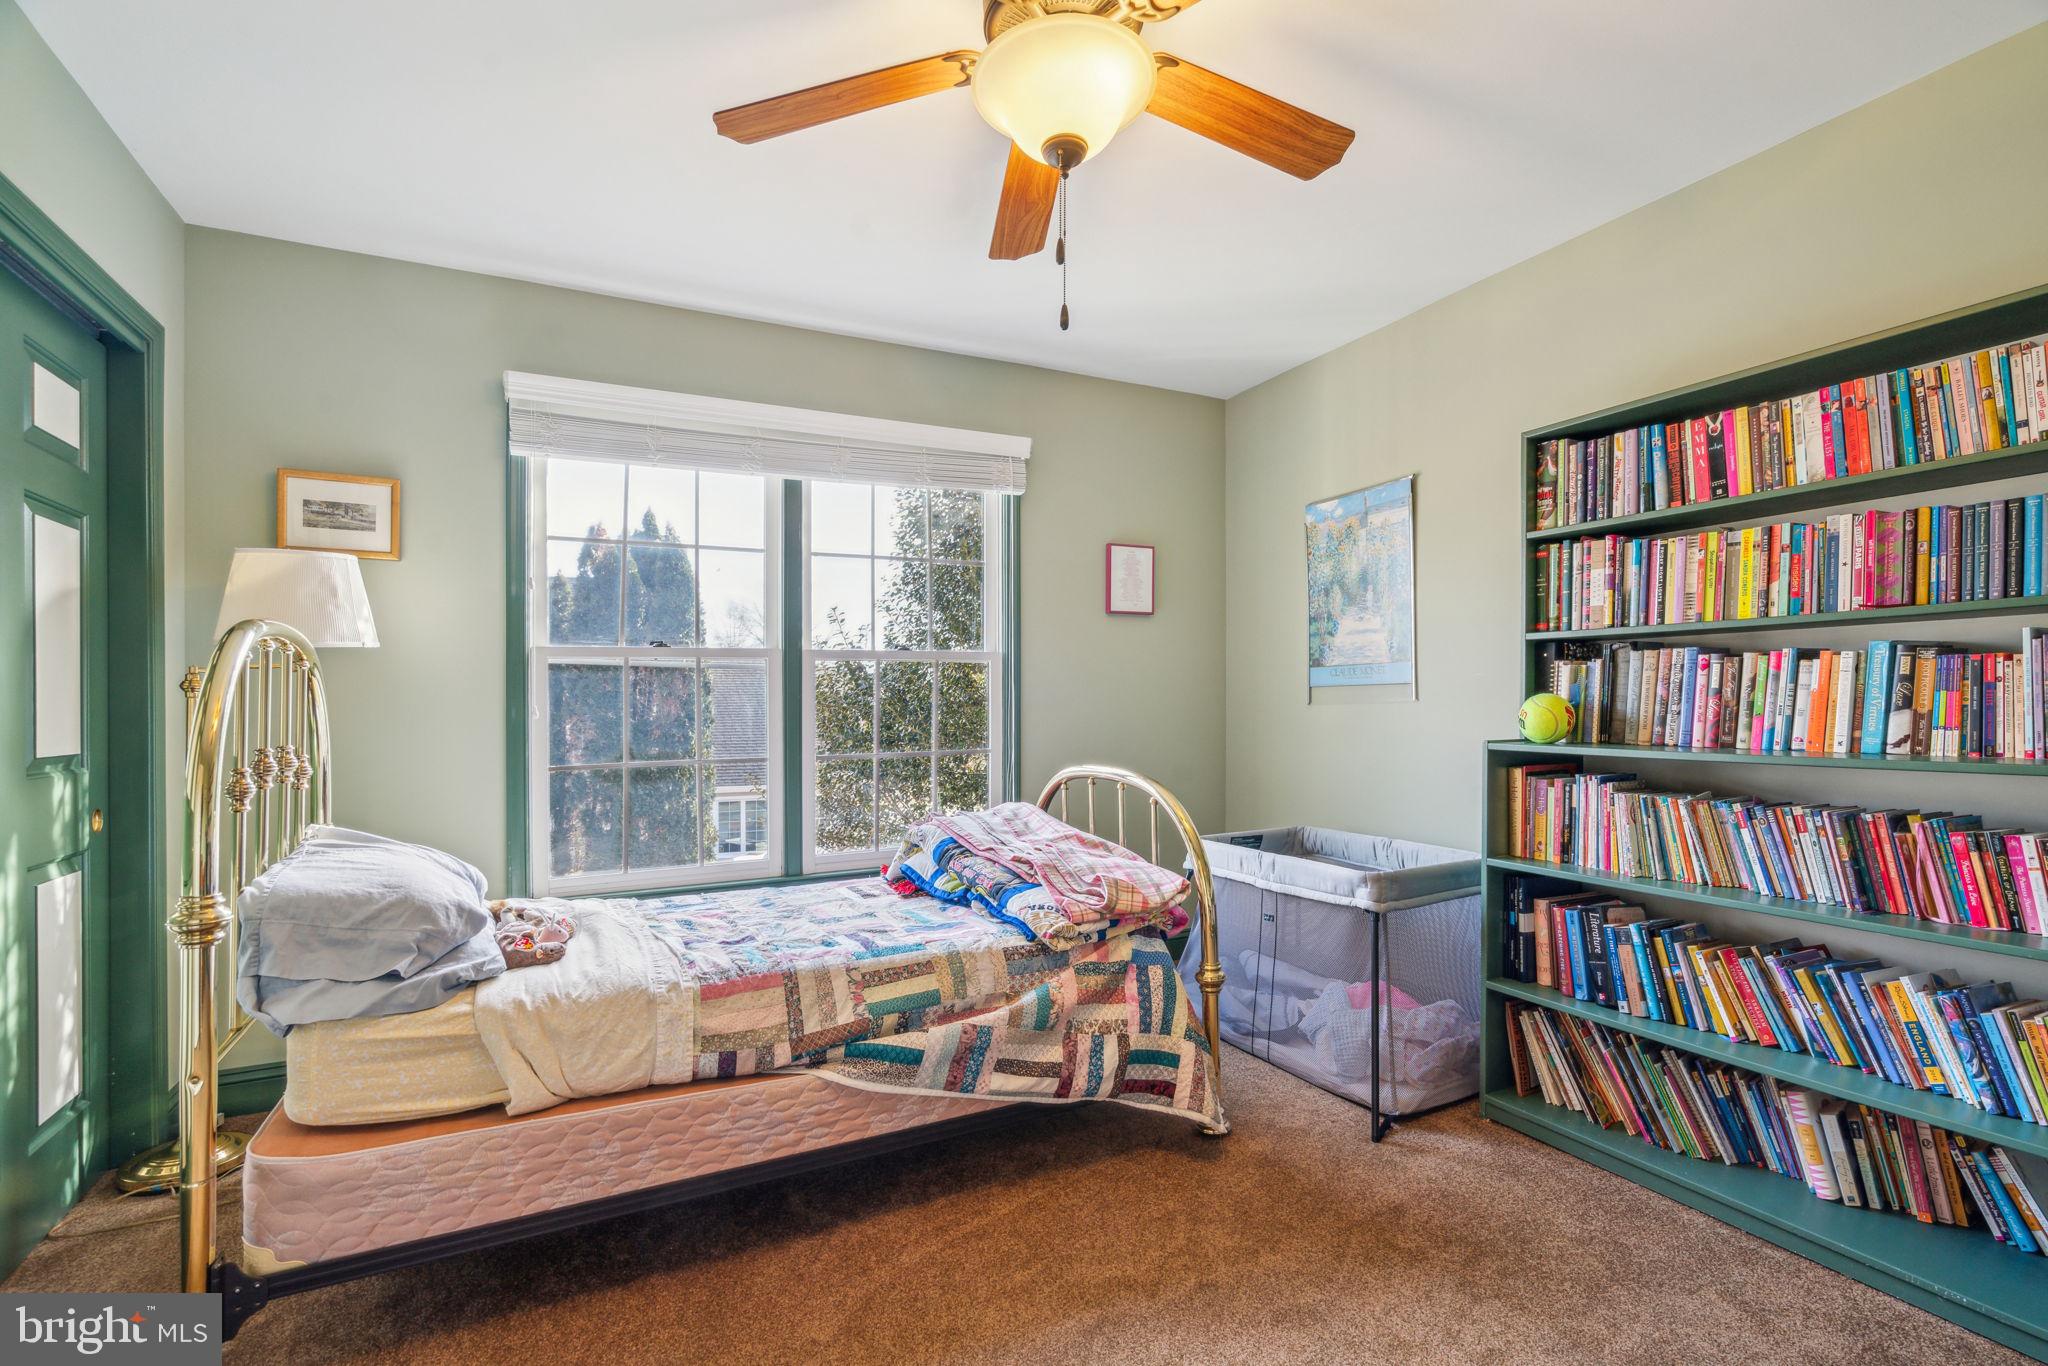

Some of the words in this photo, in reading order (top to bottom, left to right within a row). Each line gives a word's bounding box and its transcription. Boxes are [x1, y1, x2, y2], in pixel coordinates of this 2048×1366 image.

[1955, 378, 1964, 402] BALLET
[2036, 390, 2046, 409] GUITAR
[1958, 402, 1966, 423] SHOES
[2038, 410, 2046, 422] GIRL
[1824, 436, 1832, 457] A-LIST
[1854, 548, 1862, 569] PARIS
[1871, 649, 1884, 686] Treasury
[1901, 657, 1910, 673] ENVY
[1922, 661, 1930, 676] JODI
[1663, 665, 1671, 688] HARRY
[1872, 687, 1881, 697] of
[1896, 682, 1912, 707] Luxe
[1868, 698, 1881, 732] Virtues
[1509, 786, 1518, 802] Help
[1536, 797, 1545, 810] Help
[1960, 858, 1973, 884] Princess
[1997, 854, 2010, 880] SCRIBBLER
[2015, 864, 2024, 875] The
[1966, 883, 1974, 891] in
[2003, 880, 2011, 888] OF
[2017, 874, 2029, 897] Princess
[1967, 890, 1978, 906] Love
[2022, 896, 2033, 917] Diaries
[1555, 929, 1564, 957] CATCHING
[1587, 911, 1604, 954] Literature
[1605, 927, 1613, 939] DUTY
[1729, 952, 1746, 981] CUTTING
[1741, 979, 1752, 993] FOR
[1750, 998, 1767, 1028] ABRAHAM
[1958, 993, 1971, 1014] NAPOLI
[1907, 1021, 1932, 1066] ENGLAND
[1994, 1043, 2004, 1058] Summer
[2001, 1204, 2011, 1214] the
[2006, 1213, 2024, 1239] Spotlight
